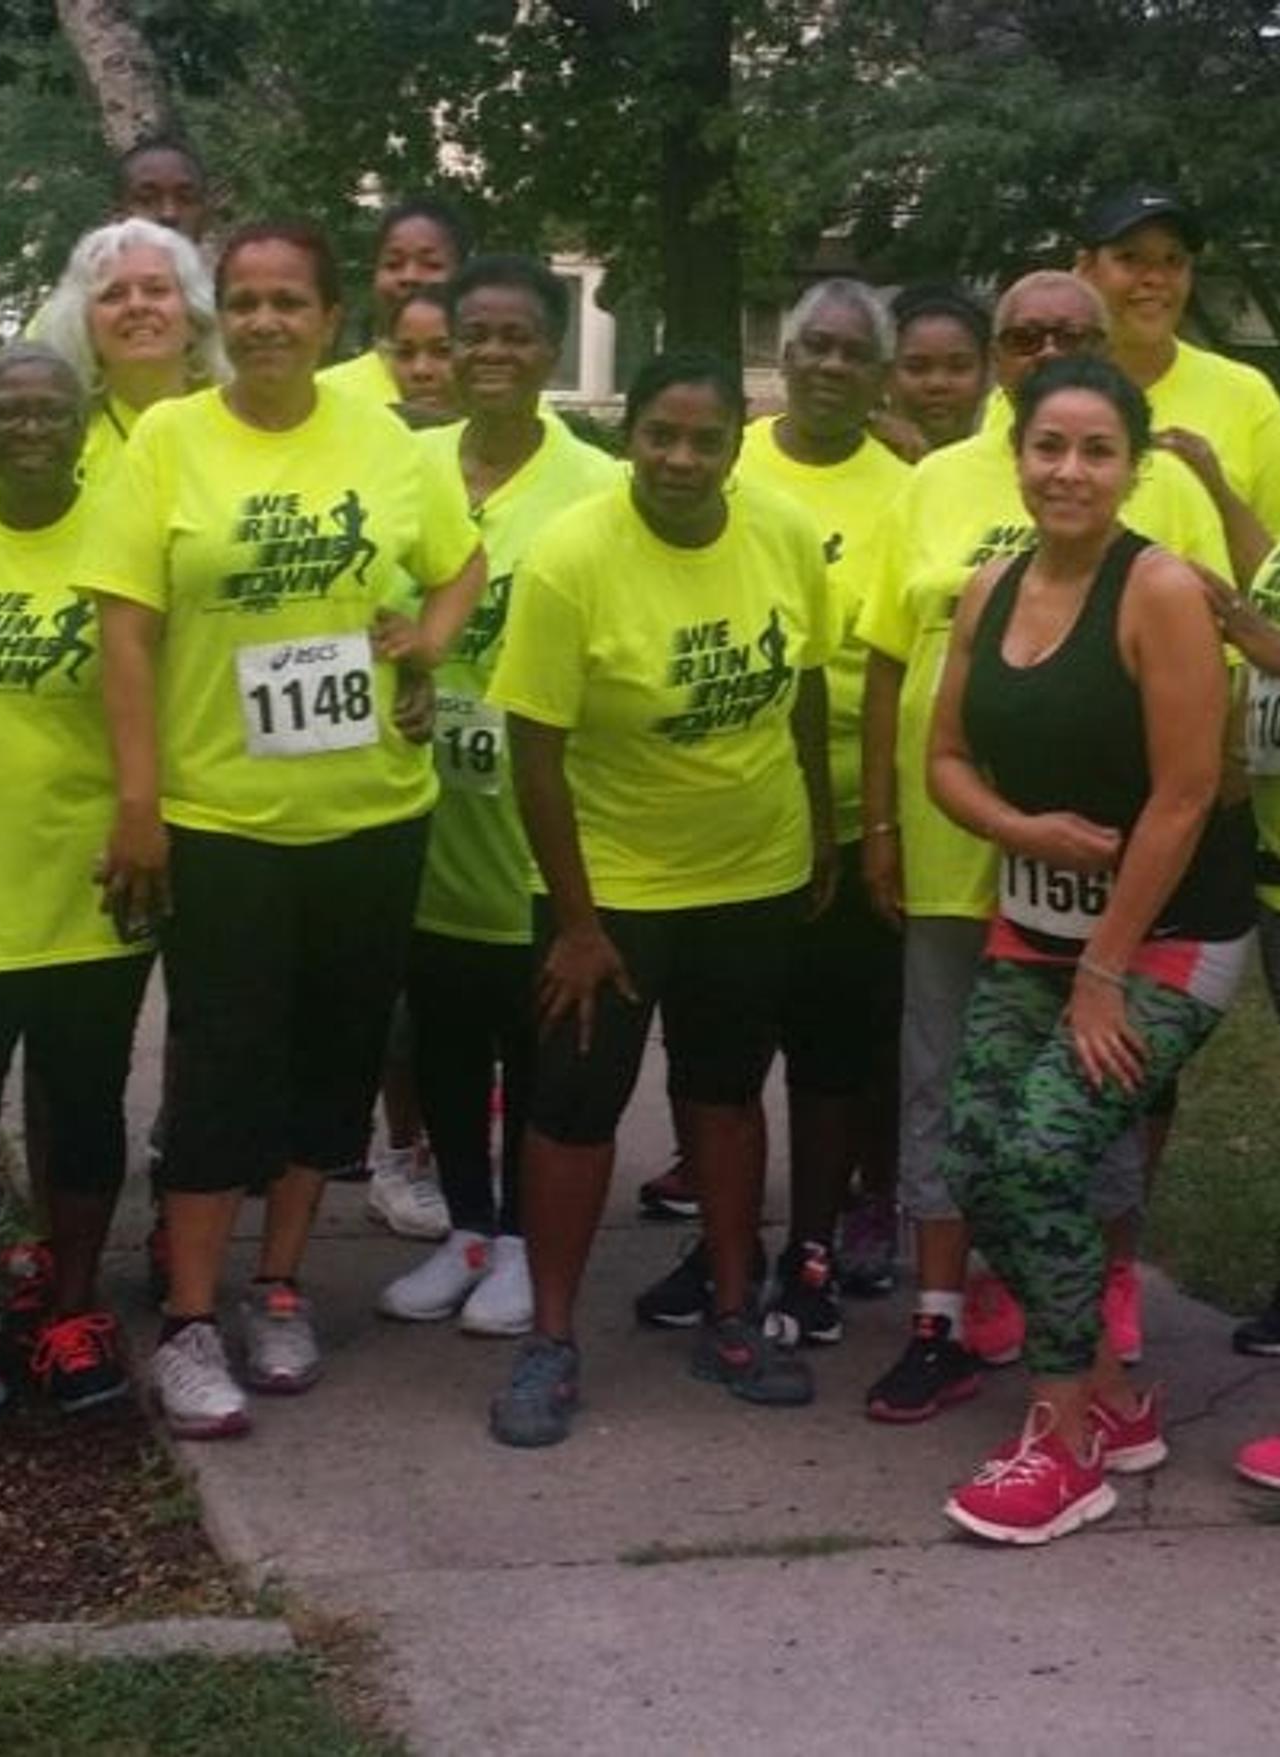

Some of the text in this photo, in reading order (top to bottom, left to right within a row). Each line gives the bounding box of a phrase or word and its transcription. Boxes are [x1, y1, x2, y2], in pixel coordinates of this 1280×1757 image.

[244, 493, 300, 517] WE
[236, 515, 320, 543] RUN
[673, 619, 729, 653] WE
[667, 644, 751, 688] RUN
[249, 669, 371, 734] 1148
